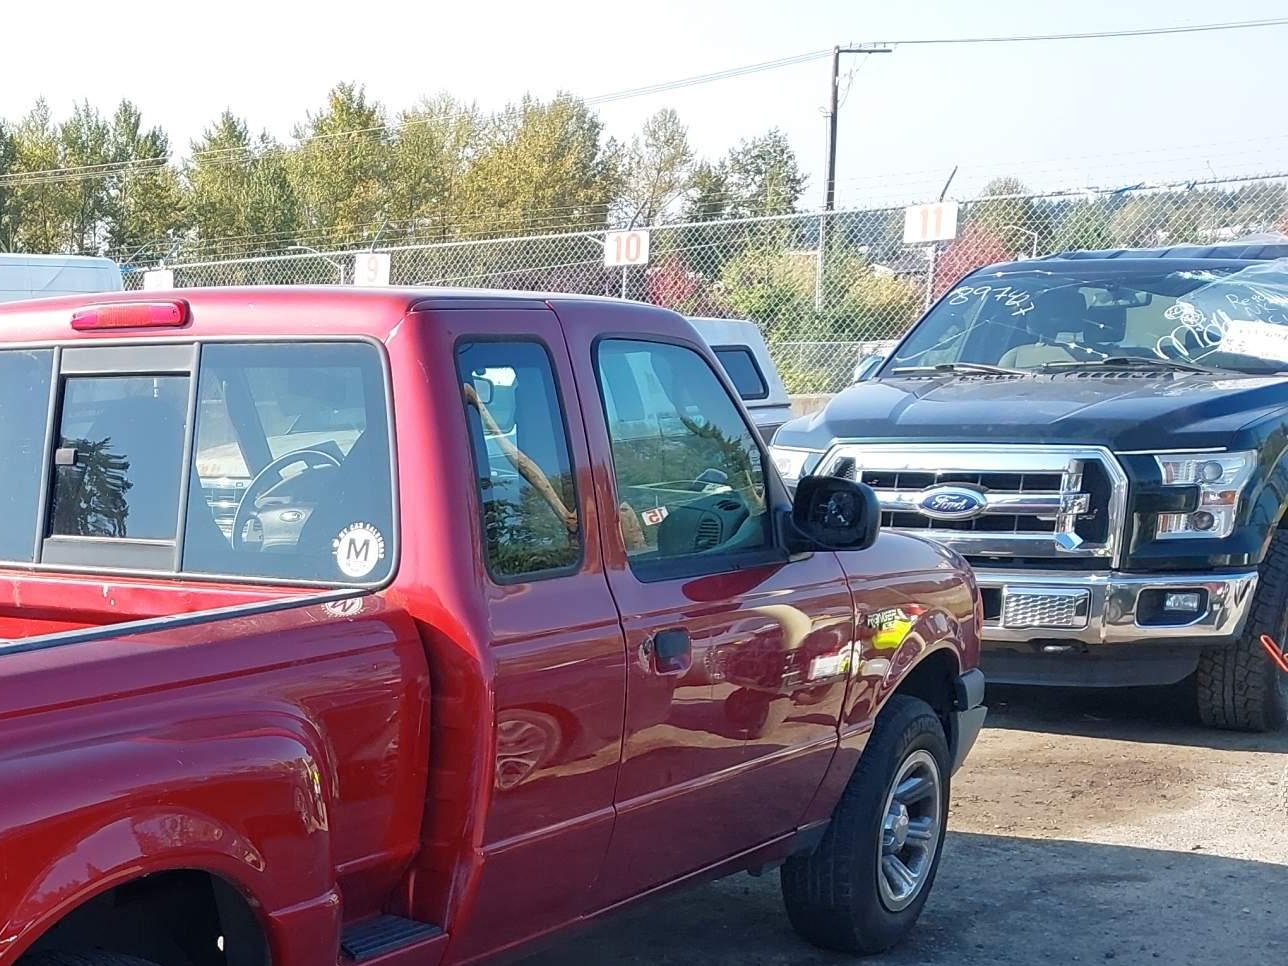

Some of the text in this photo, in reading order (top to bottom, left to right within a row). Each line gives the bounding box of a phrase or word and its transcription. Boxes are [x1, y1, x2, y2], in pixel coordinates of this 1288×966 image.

[920, 207, 943, 239] 11
[615, 233, 641, 263] 10
[366, 255, 379, 283] 9
[346, 537, 371, 562] M
